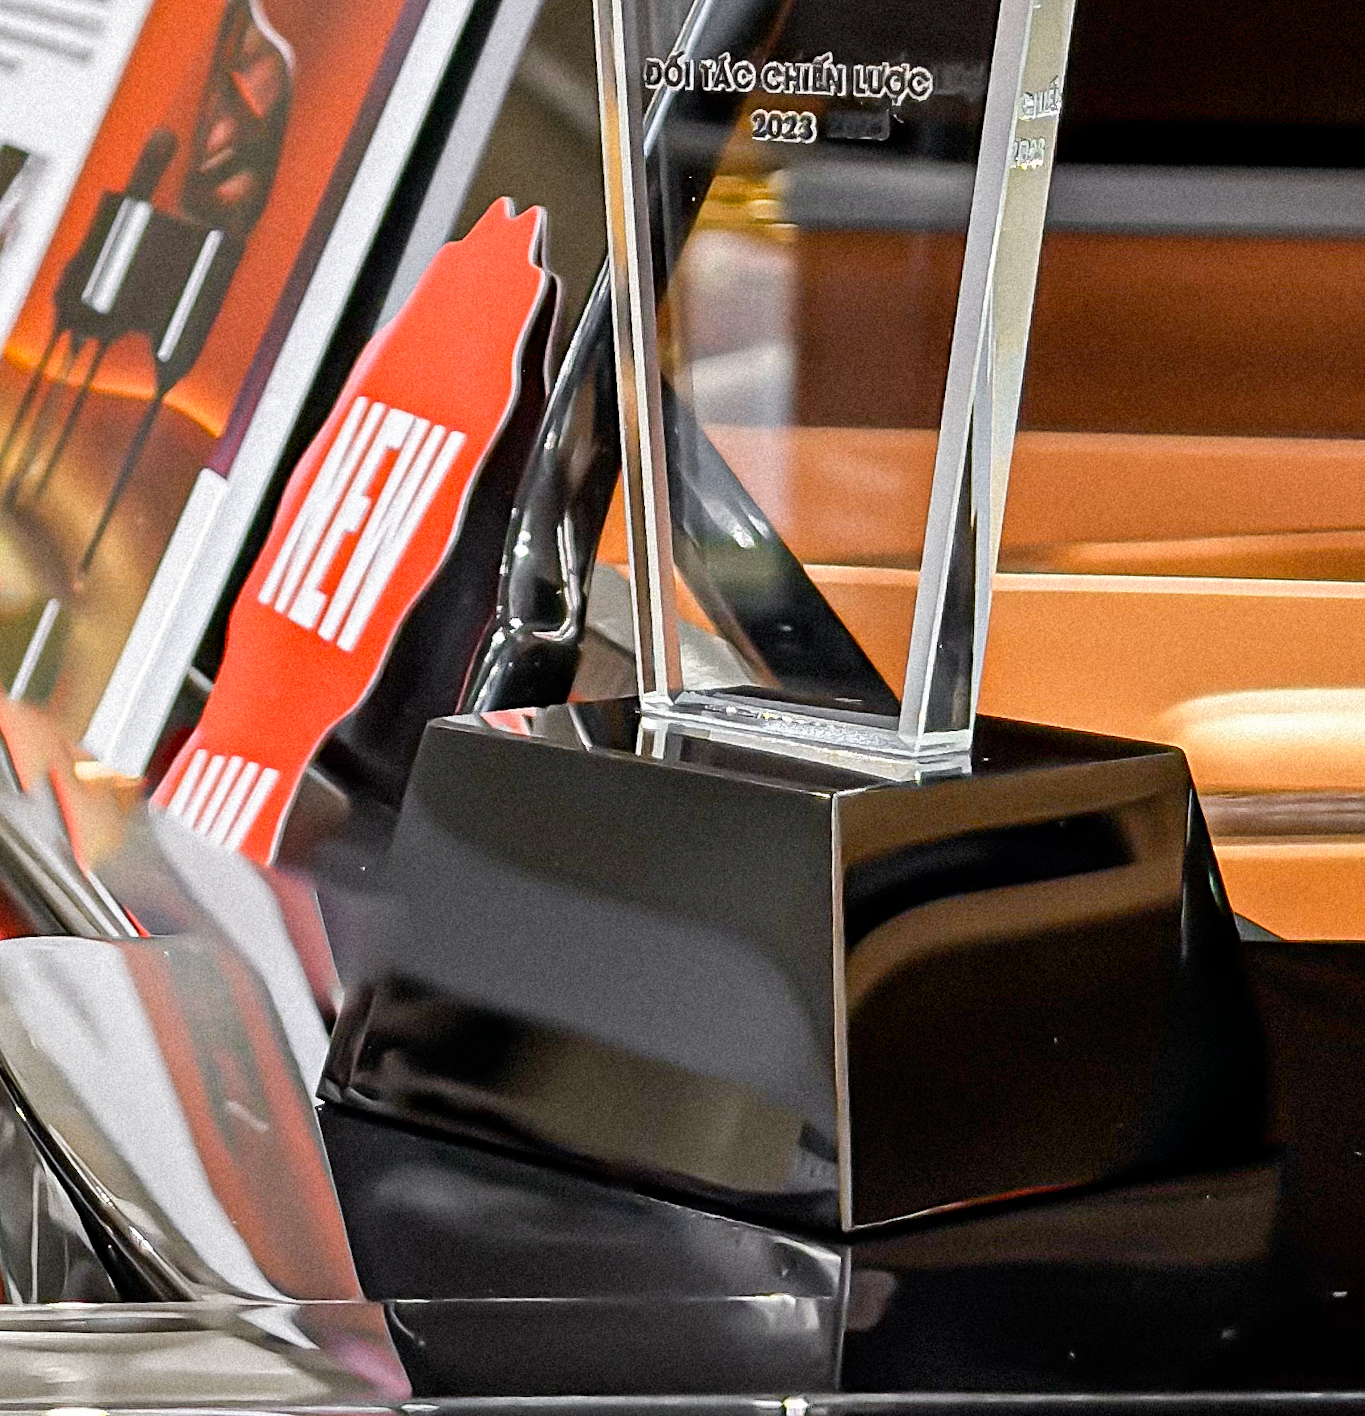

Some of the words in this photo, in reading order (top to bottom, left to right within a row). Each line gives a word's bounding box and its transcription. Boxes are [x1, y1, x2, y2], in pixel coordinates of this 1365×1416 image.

[699, 51, 757, 93] TÁC
[750, 108, 818, 144] 2023
[257, 395, 467, 654] NEW
